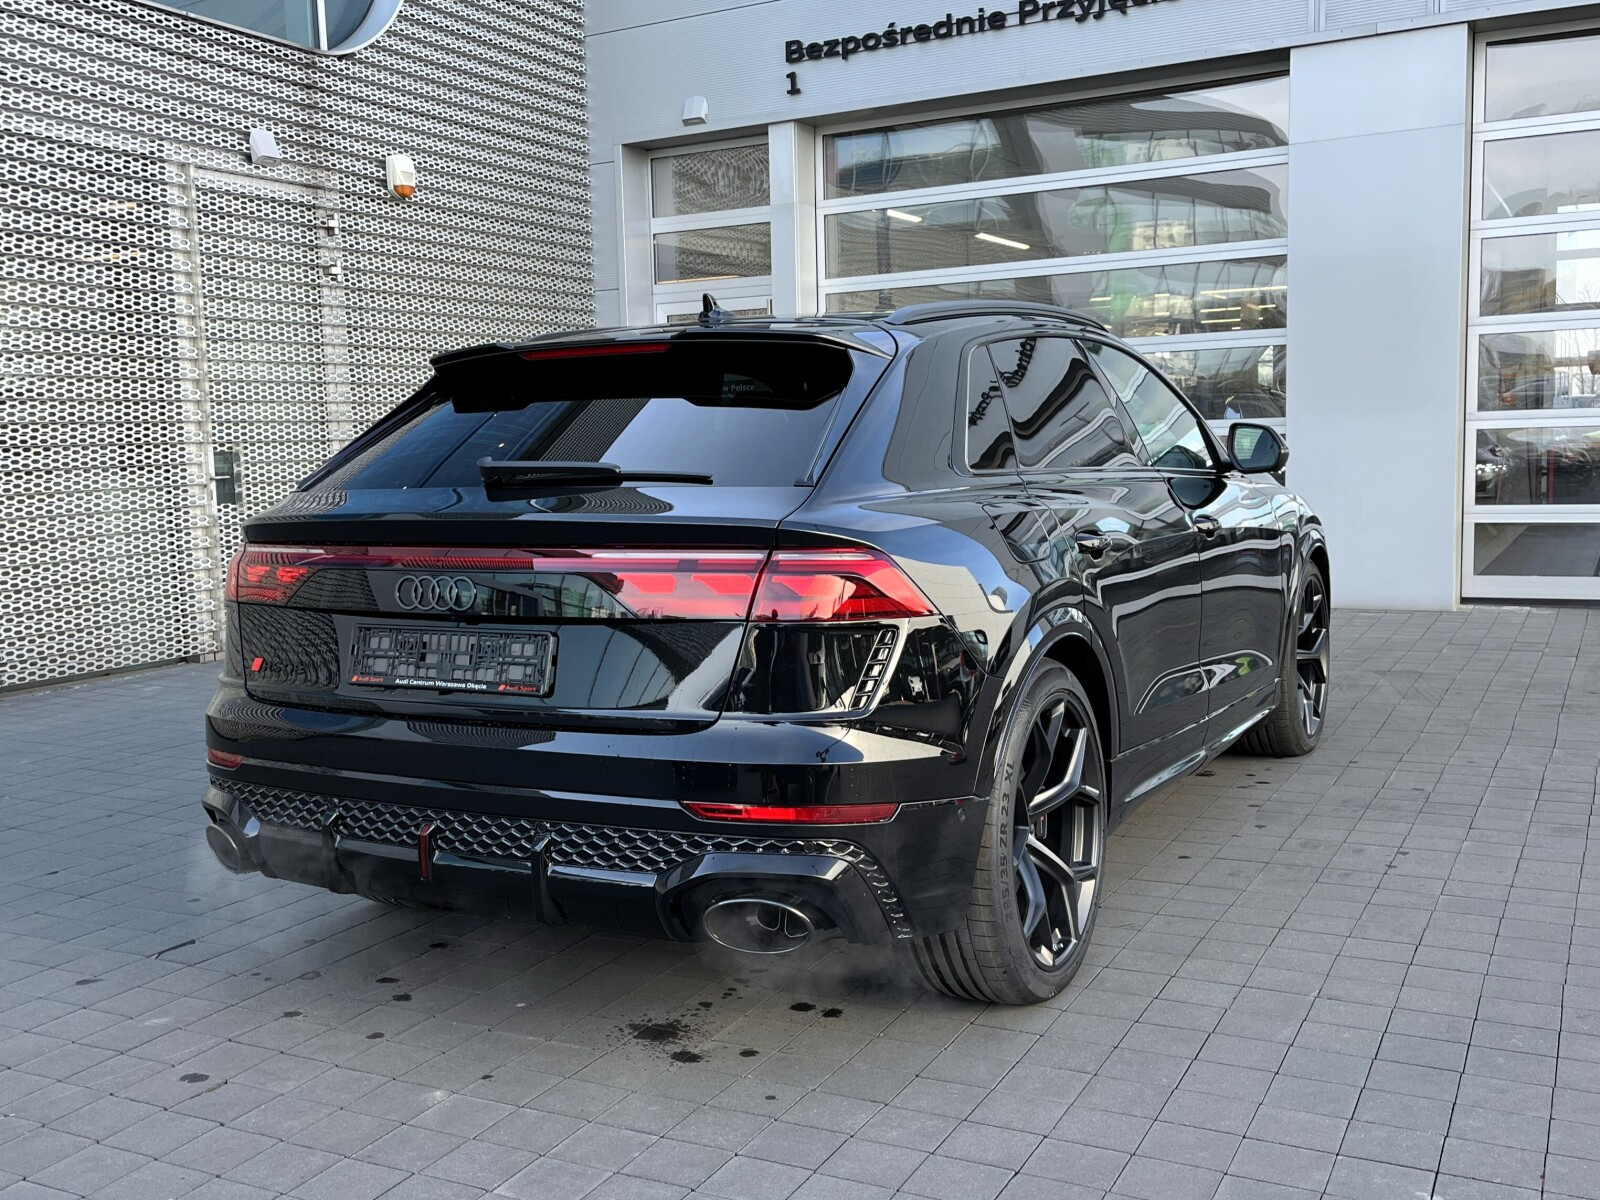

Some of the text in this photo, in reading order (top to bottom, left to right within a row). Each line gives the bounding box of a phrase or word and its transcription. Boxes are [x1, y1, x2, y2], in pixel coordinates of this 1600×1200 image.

[784, 0, 1178, 64] Bezpośrednie Przyję
[785, 71, 802, 96] 1
[730, 383, 755, 392] Polsce
[435, 680, 466, 688] Warszawa
[466, 682, 487, 690] Okęcie
[1004, 760, 1015, 785] XL
